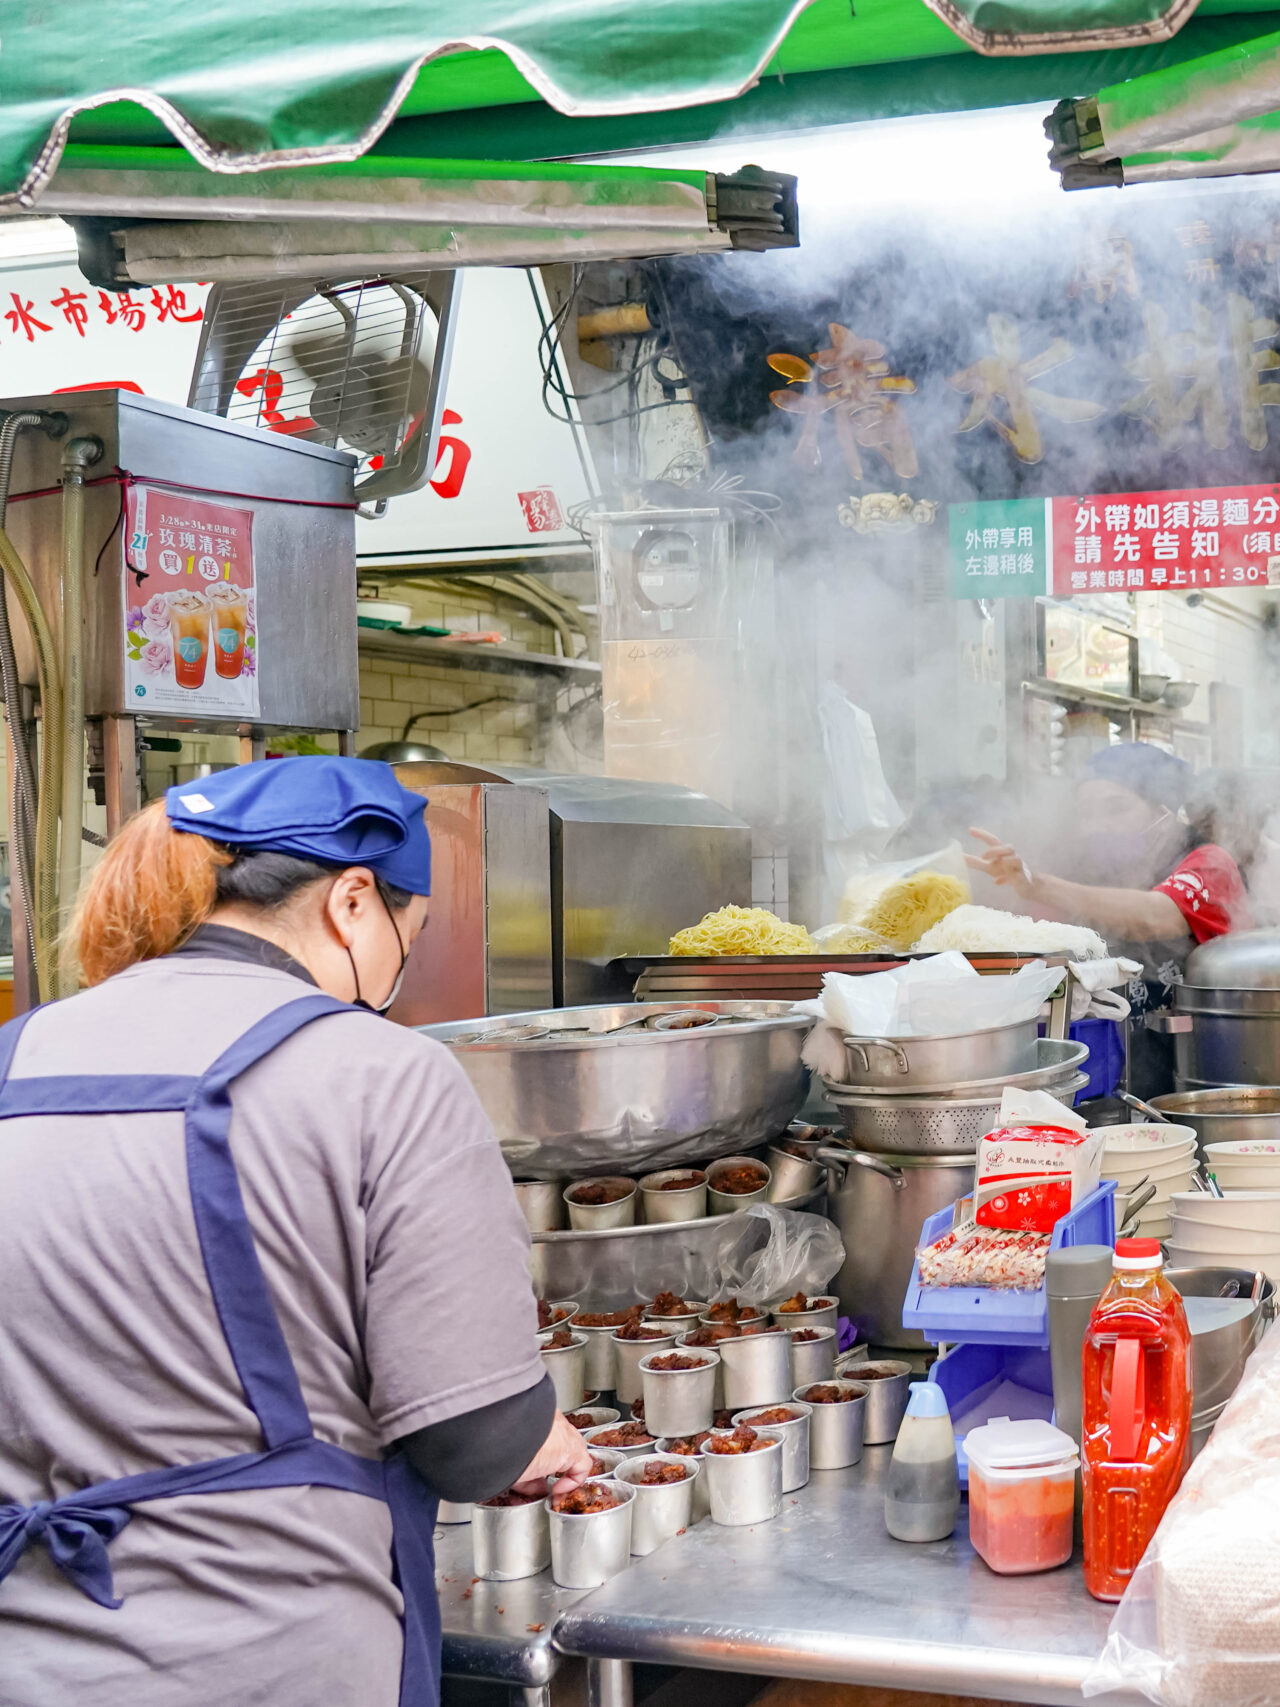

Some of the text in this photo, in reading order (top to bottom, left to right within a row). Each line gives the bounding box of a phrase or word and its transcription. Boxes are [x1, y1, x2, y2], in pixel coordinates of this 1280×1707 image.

[0, 282, 215, 343] 水市場地
[159, 527, 232, 558] 玫瑰清茶
[964, 525, 1034, 550] 外帶享用
[1074, 529, 1220, 564] 請先告知
[964, 553, 1035, 577] 左邊稍後
[1070, 568, 1144, 589] 營業時間
